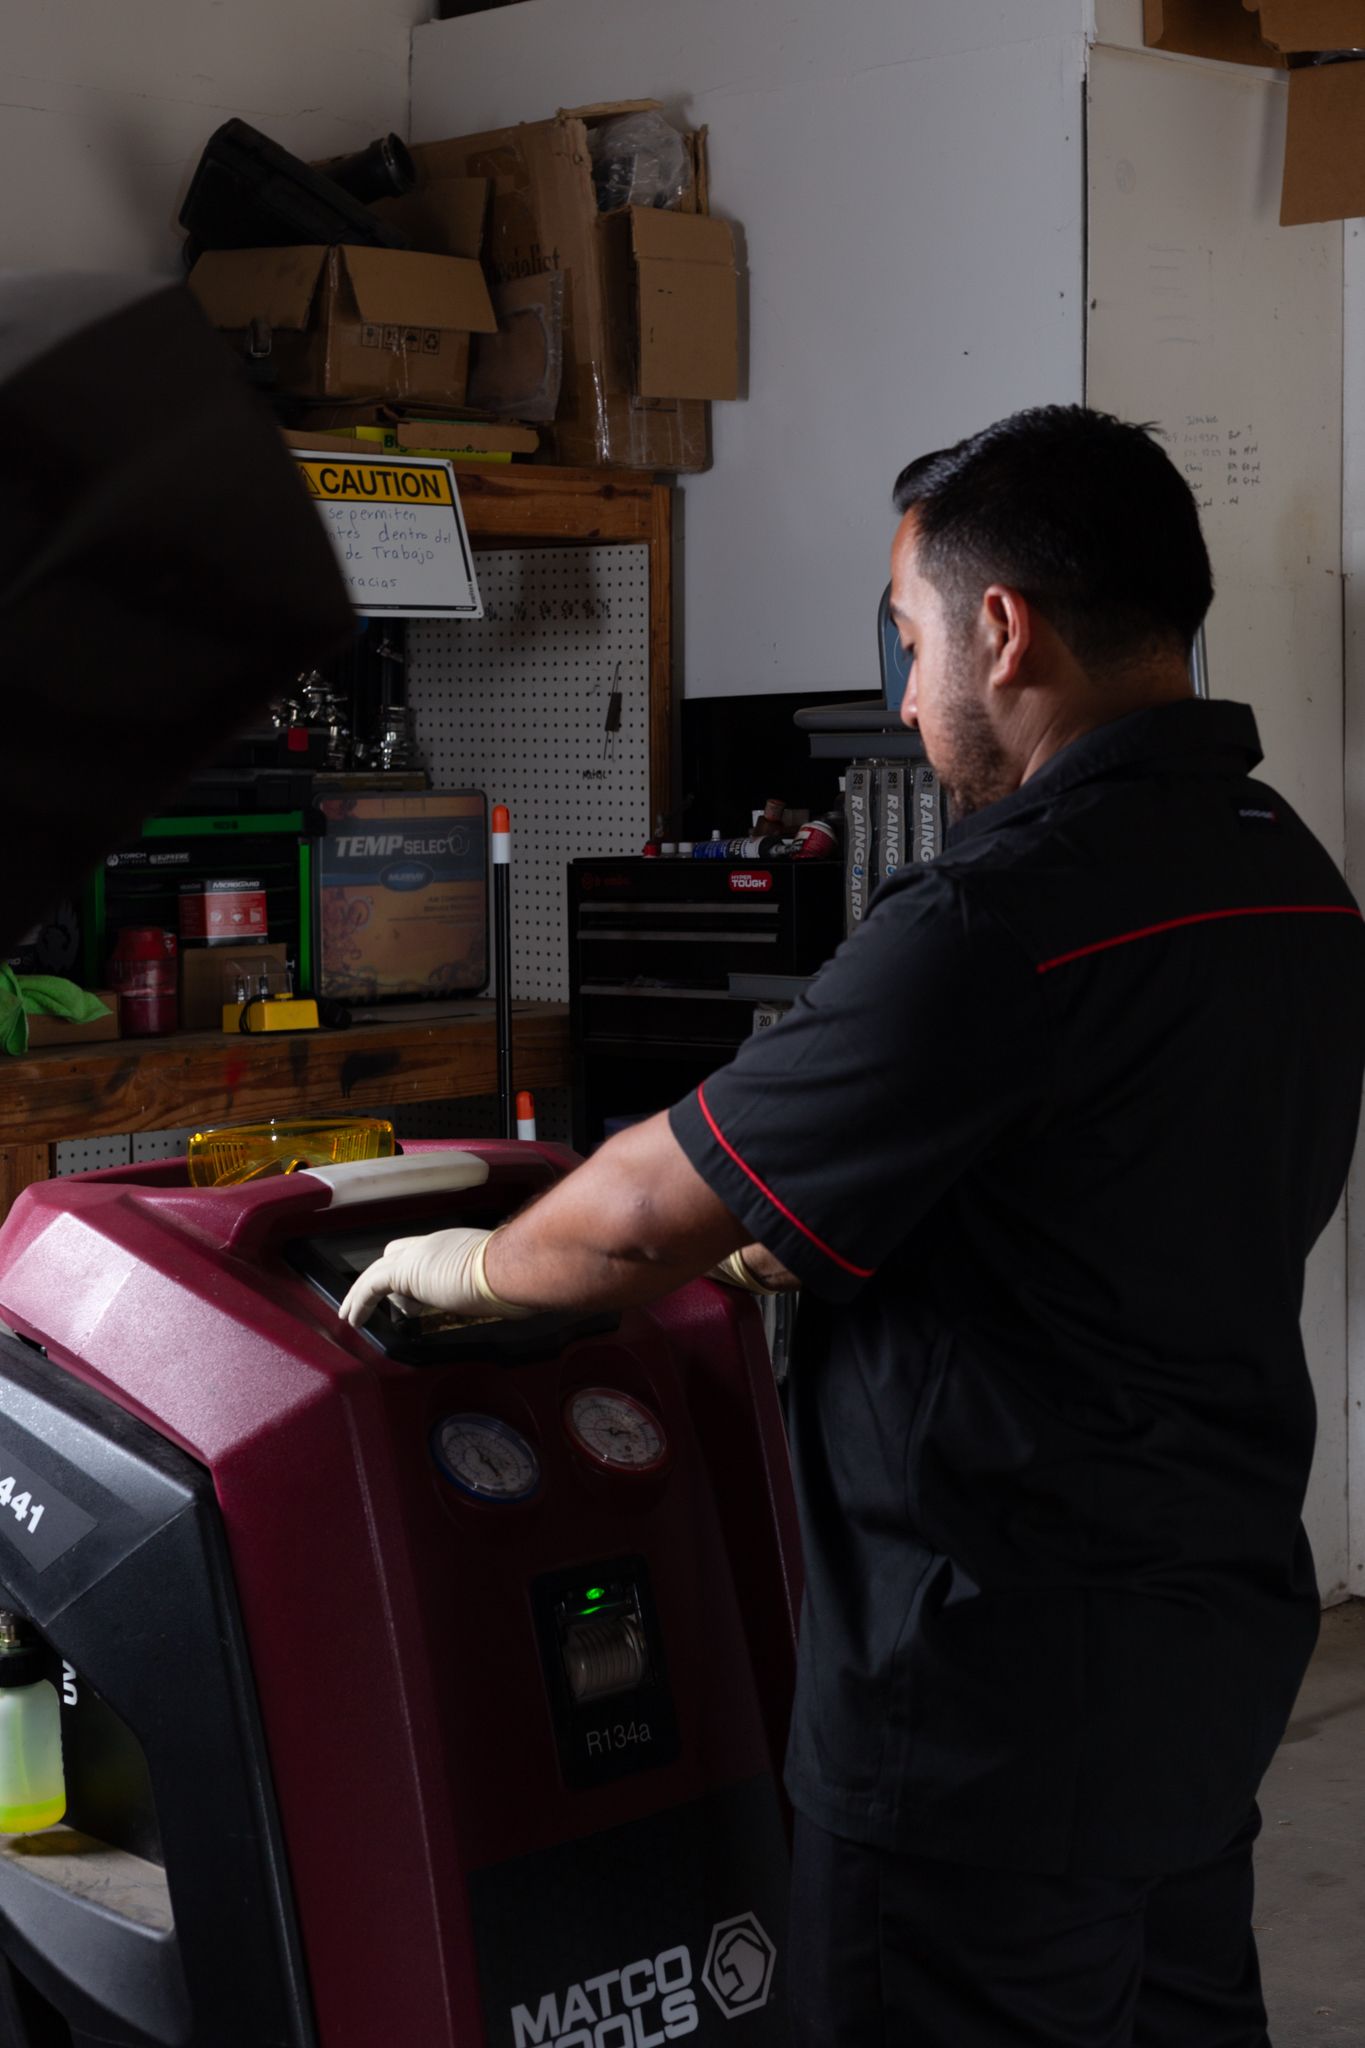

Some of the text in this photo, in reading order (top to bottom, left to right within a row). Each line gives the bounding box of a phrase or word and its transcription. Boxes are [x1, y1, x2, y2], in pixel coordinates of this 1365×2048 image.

[320, 468, 441, 499] CAUTION
[349, 508, 417, 530] permiten
[378, 522, 428, 543] dentro
[434, 528, 451, 544] del
[346, 543, 434, 565] de Trabajo
[853, 773, 863, 785] 28
[888, 772, 898, 784] 28
[922, 771, 934, 783] 26
[335, 835, 404, 858] TEMP
[851, 795, 867, 921] RAINGUARD
[731, 879, 767, 889] TOUGH
[759, 1015, 772, 1027] 20
[585, 1721, 652, 1757] R134a
[510, 1944, 693, 2048] MATCO
